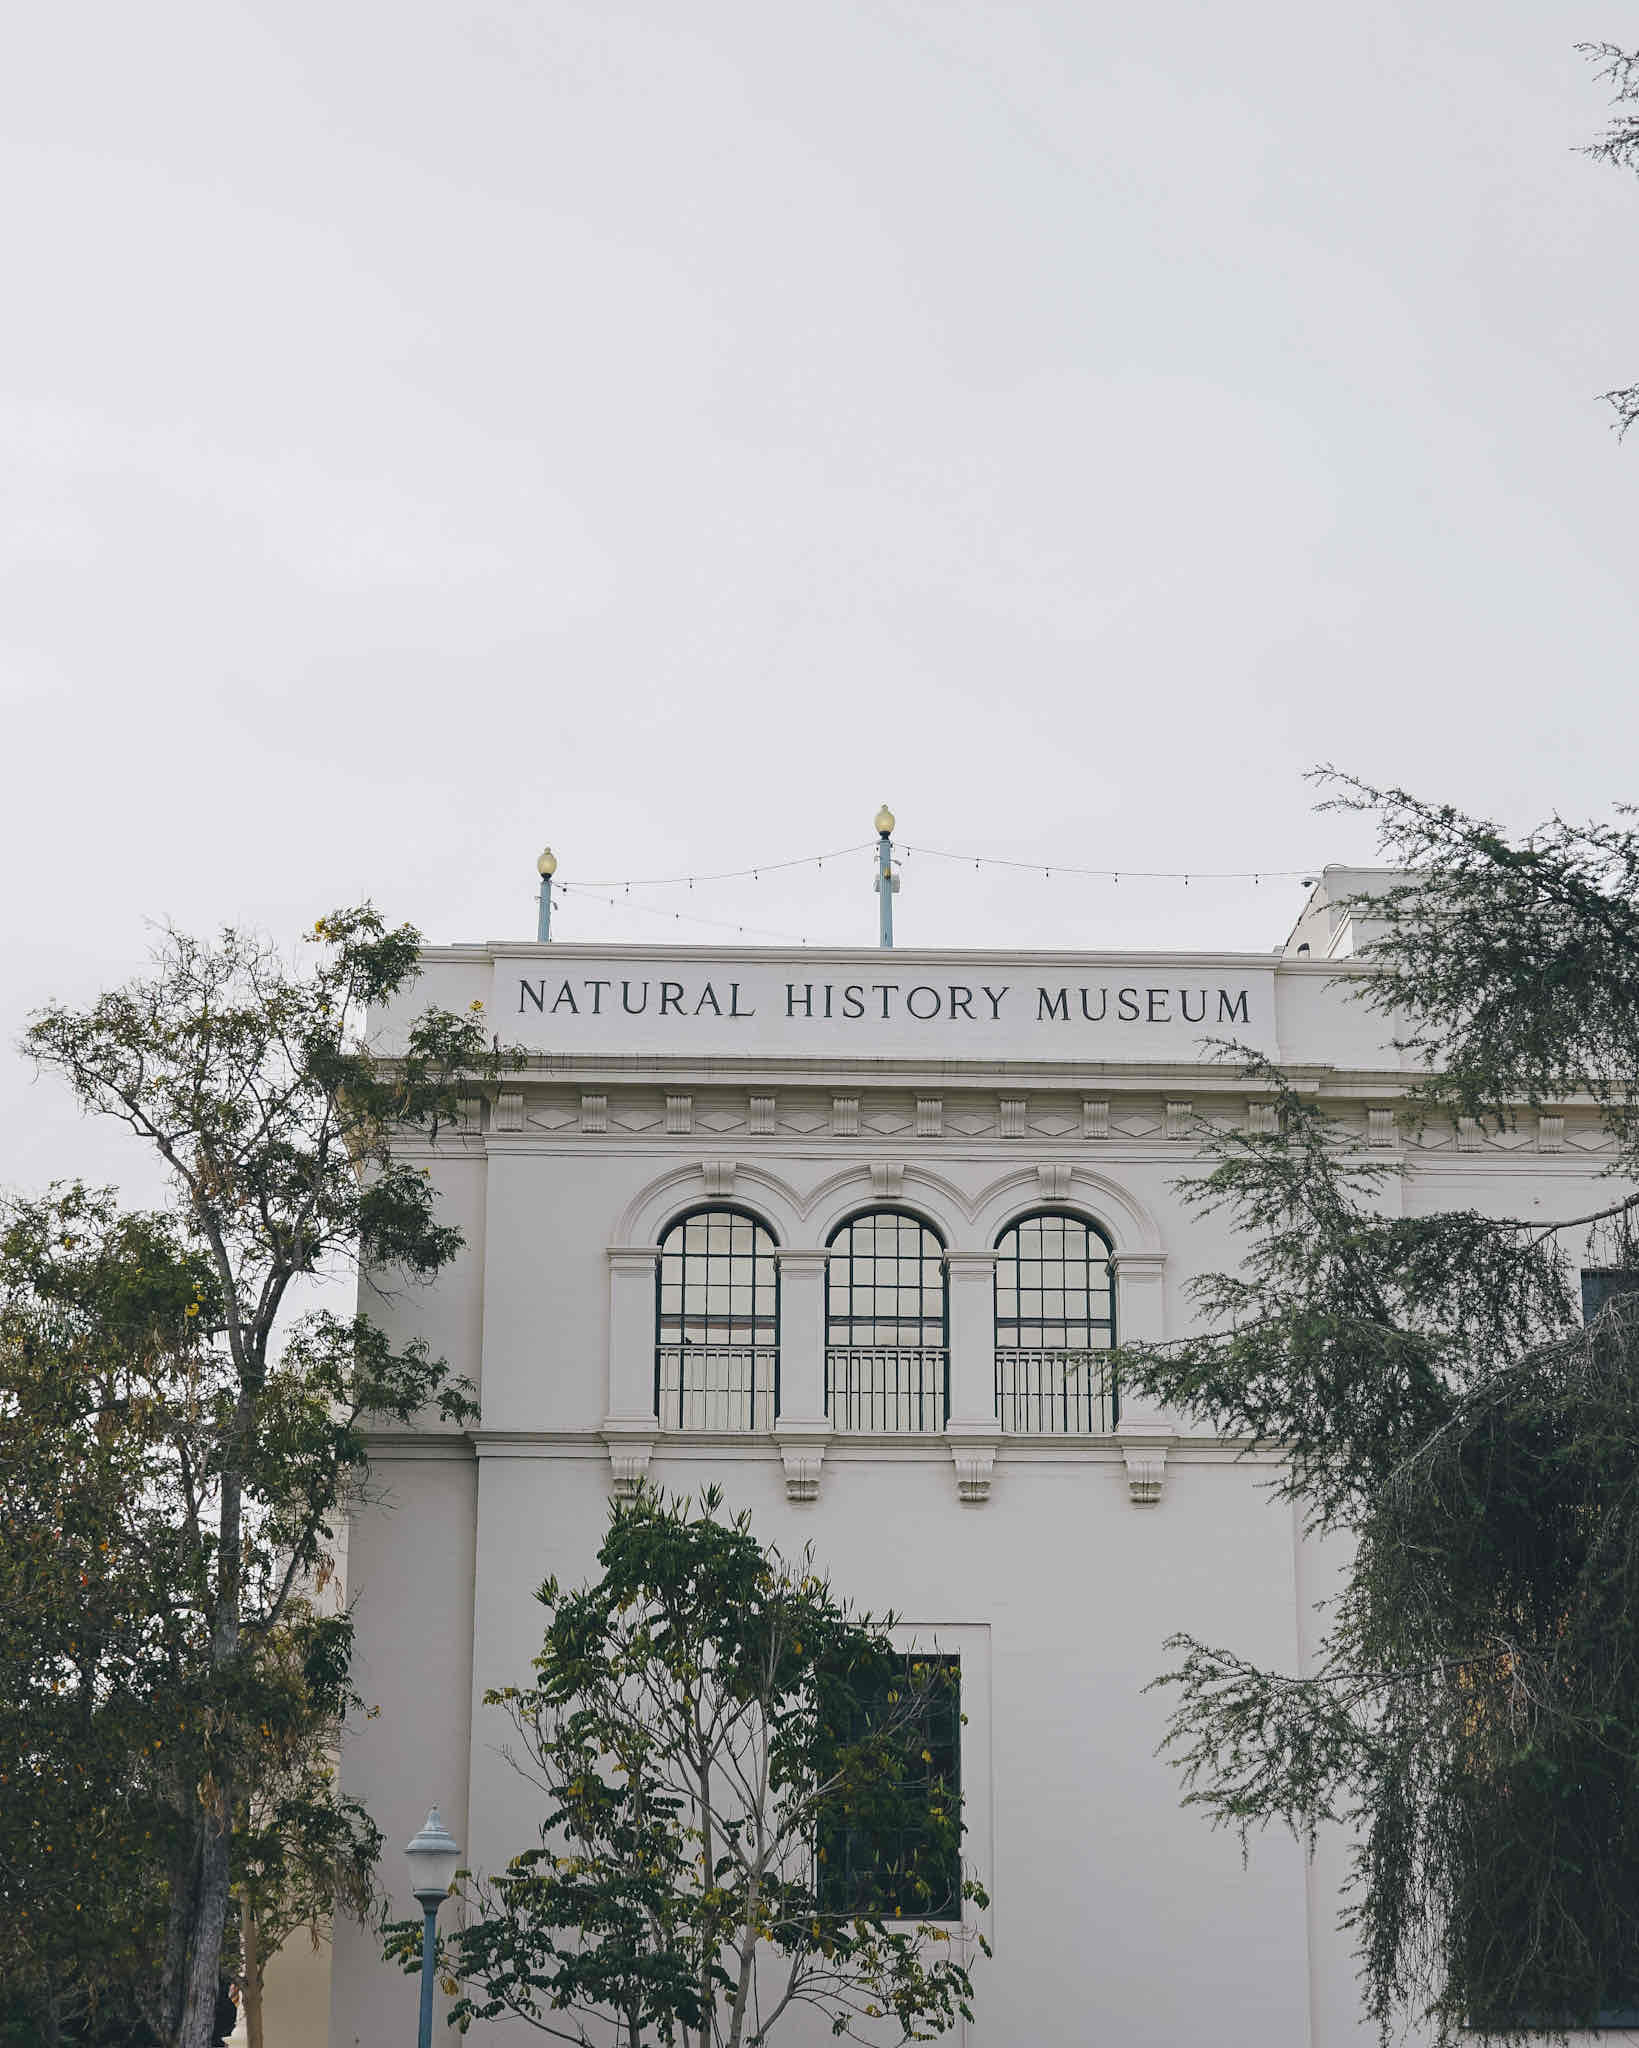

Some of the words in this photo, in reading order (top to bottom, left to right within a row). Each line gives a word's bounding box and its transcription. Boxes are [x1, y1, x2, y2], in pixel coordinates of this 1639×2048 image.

[518, 979, 756, 1019] NATURAL
[784, 983, 1011, 1020] HISTORY
[1036, 986, 1251, 1024] MUSEUM
